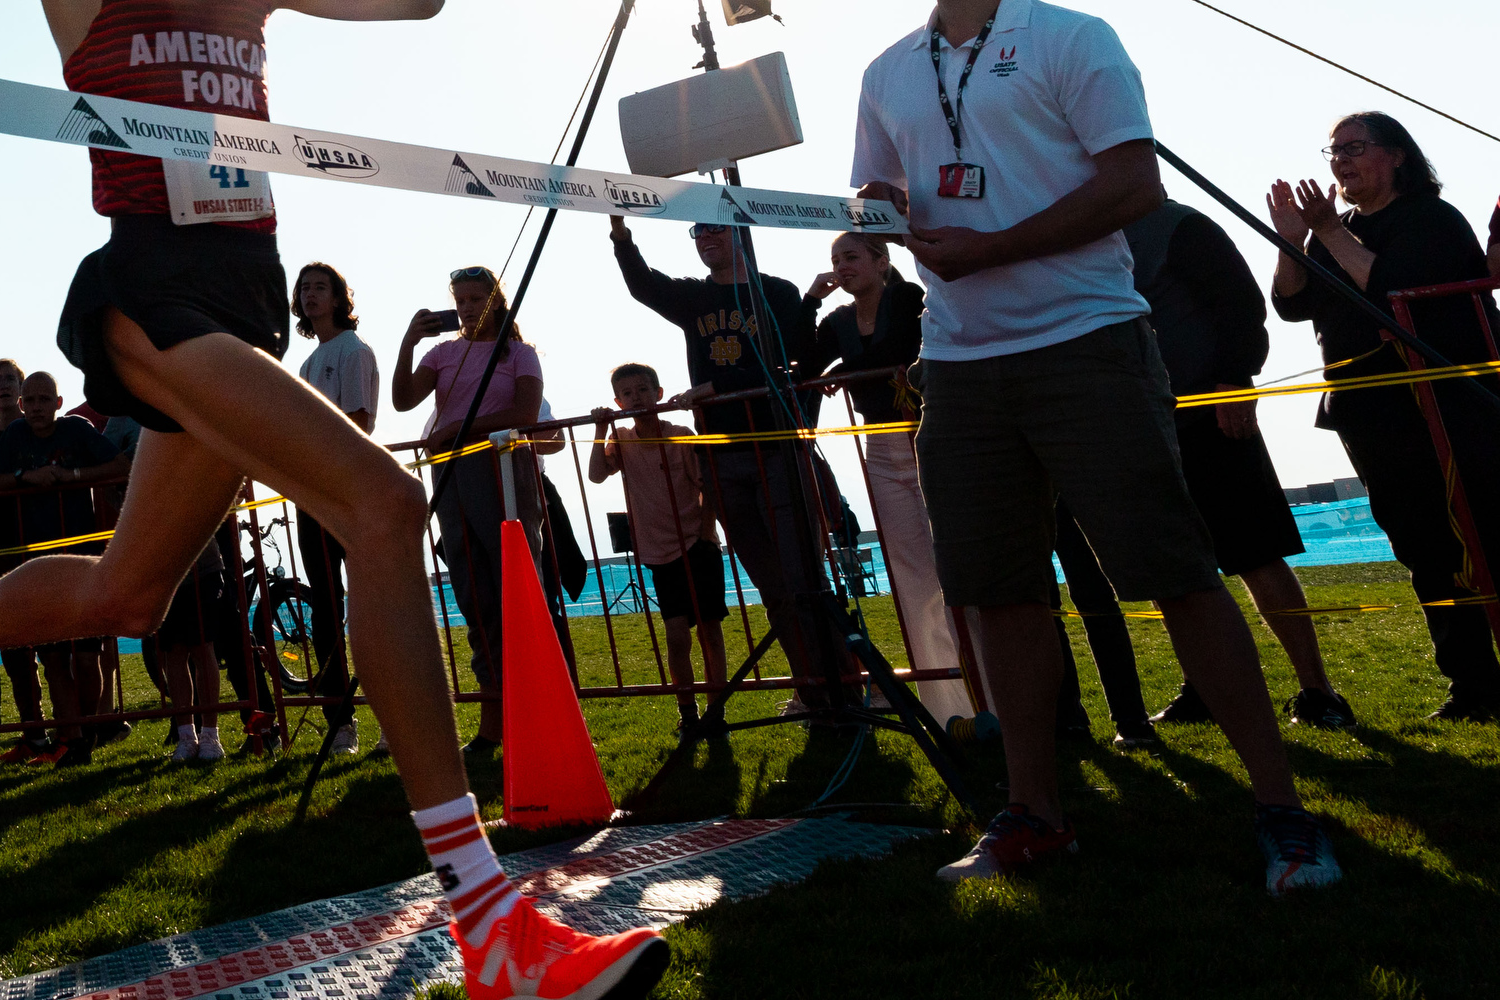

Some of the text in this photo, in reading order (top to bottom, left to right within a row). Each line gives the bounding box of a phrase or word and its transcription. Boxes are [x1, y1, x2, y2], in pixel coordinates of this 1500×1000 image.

[181, 69, 257, 111] FORK
[173, 147, 248, 165] CREDIT UNION
[301, 144, 373, 169] UHSAA
[523, 193, 575, 207] CREDIT UNION
[610, 187, 661, 206] UHSAA
[193, 199, 227, 215] UHSAA
[845, 209, 891, 223] UHSAA
[696, 308, 759, 338] IRISH
